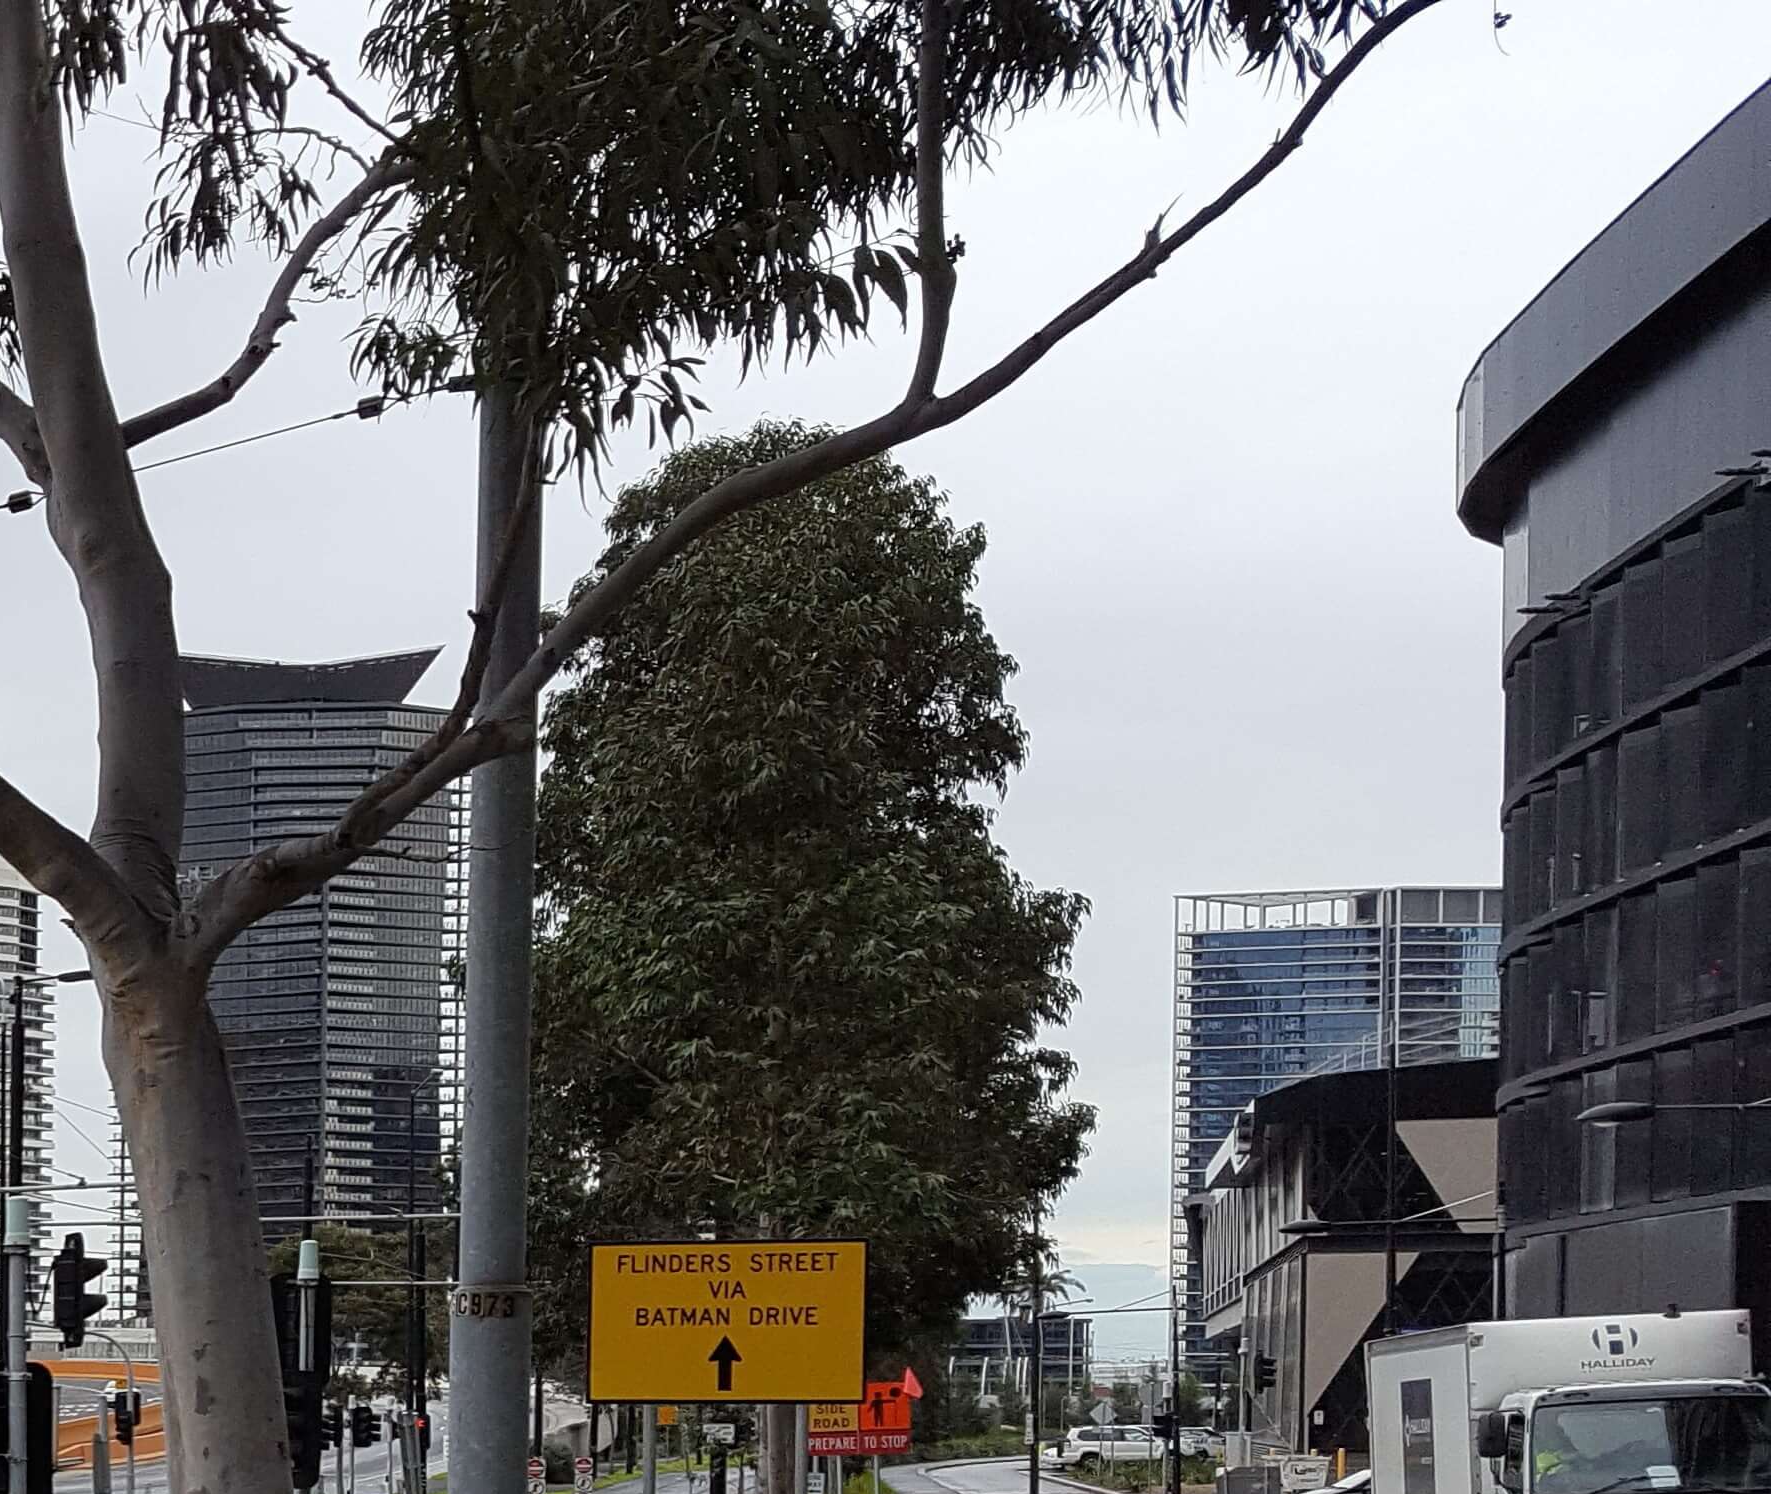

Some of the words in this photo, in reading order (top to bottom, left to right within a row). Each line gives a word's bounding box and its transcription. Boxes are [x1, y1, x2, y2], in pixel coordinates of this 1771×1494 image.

[617, 1254, 732, 1273] FLINDERS
[749, 1252, 839, 1272] STREET
[708, 1280, 747, 1299] VIA
[634, 1308, 731, 1327] BATMAN
[749, 1307, 819, 1326] DRIVE
[1580, 1357, 1656, 1370] HALLIDAY
[815, 1404, 847, 1415] SIDE
[813, 1417, 850, 1429] ROAD
[808, 1436, 858, 1450] PREPARE
[863, 1436, 877, 1449] TO
[881, 1435, 908, 1448] STOP
